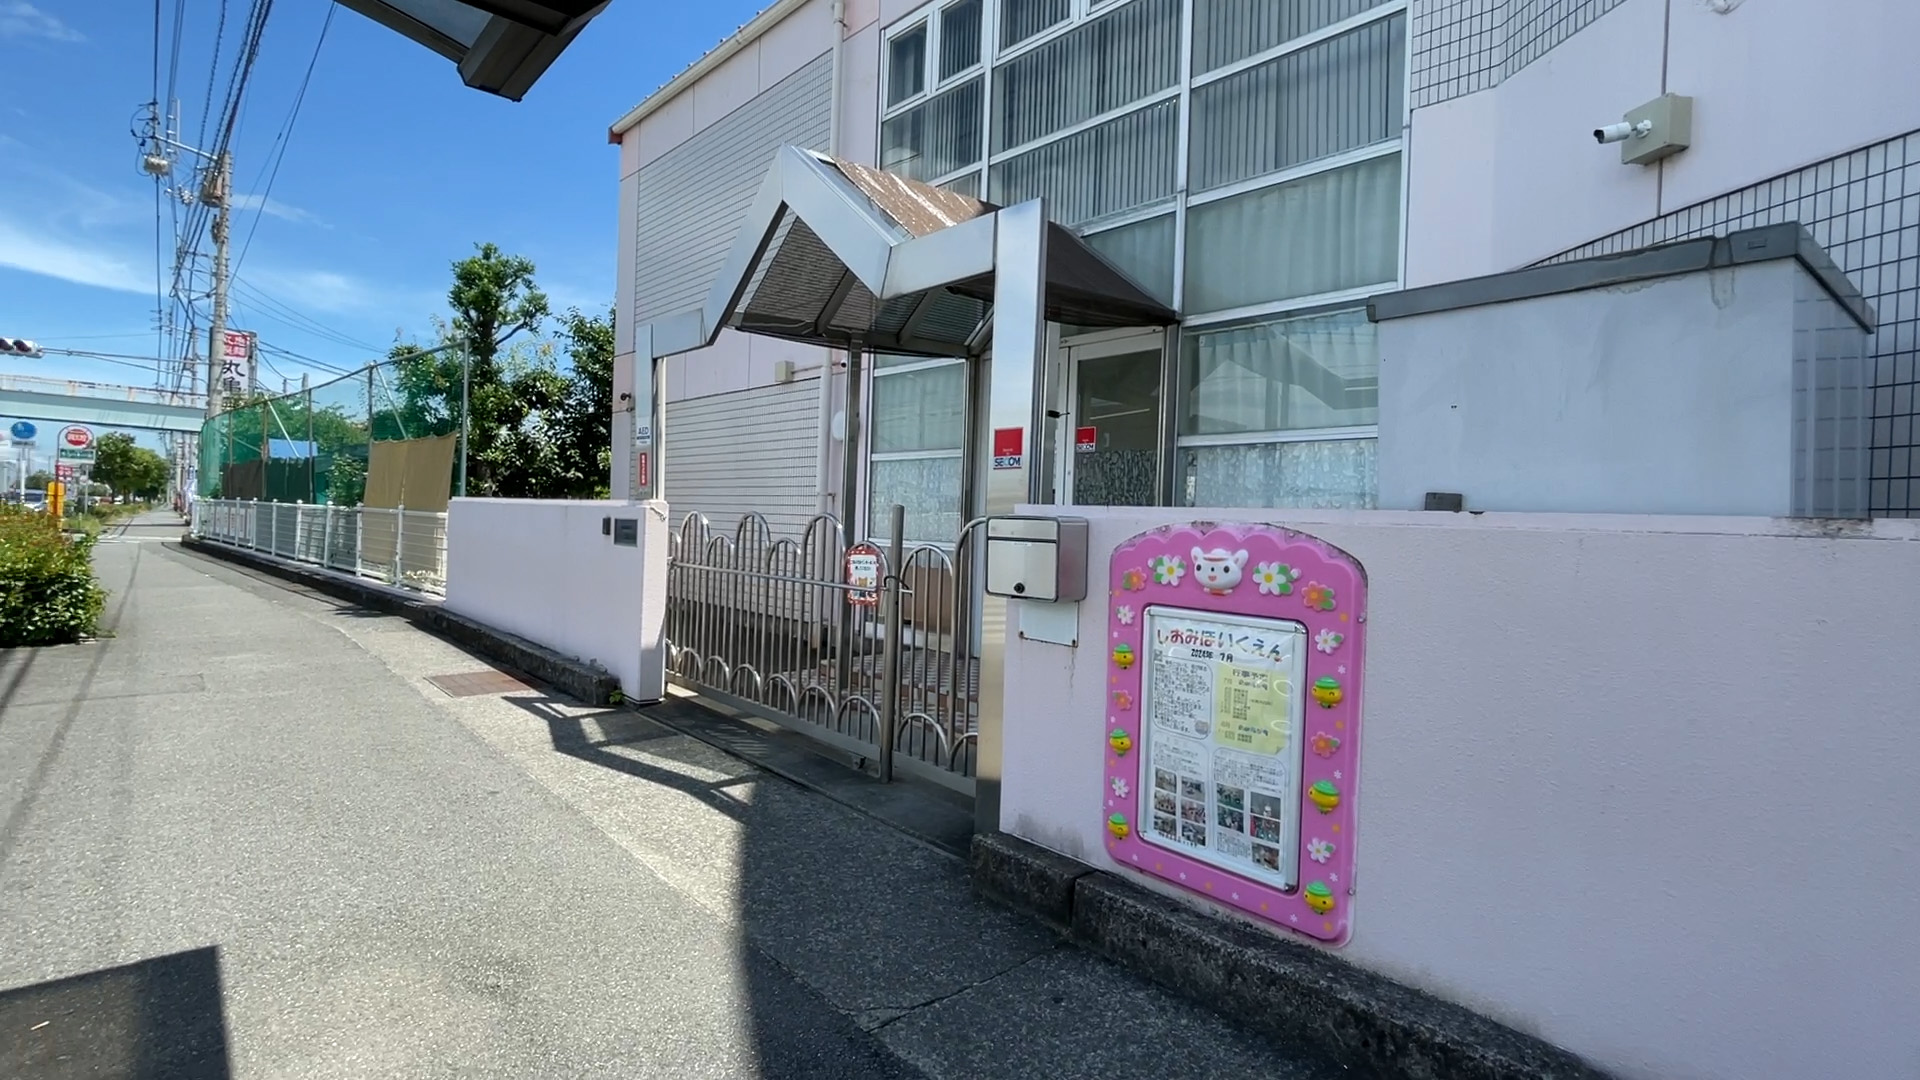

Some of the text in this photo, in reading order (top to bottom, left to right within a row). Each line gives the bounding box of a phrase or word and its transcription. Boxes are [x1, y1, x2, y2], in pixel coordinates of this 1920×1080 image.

[994, 457, 1021, 467] SECOM
[1157, 628, 1284, 662] しおみほいくえん
